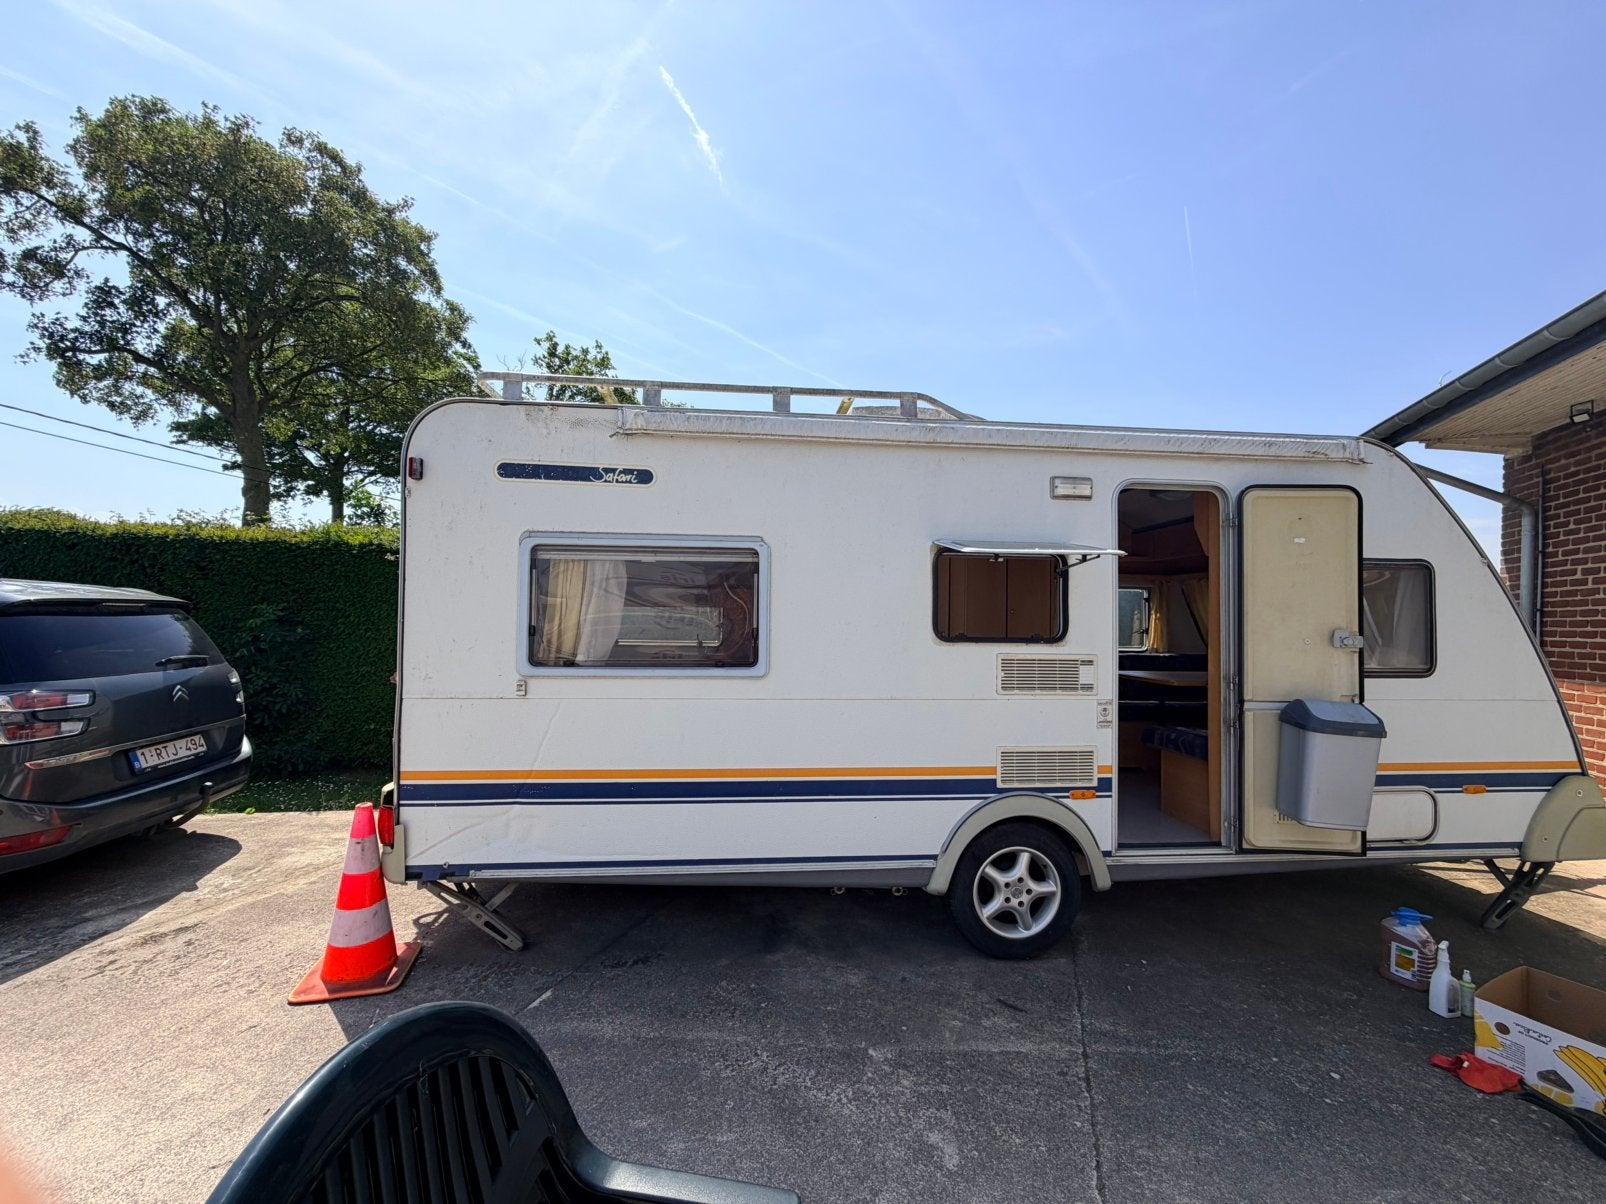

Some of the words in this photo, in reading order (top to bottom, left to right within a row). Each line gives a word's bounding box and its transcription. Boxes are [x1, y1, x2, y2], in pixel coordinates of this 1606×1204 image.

[590, 467, 638, 484] Safari
[140, 736, 205, 765] 1-RTJ-494
[134, 761, 141, 769] B
